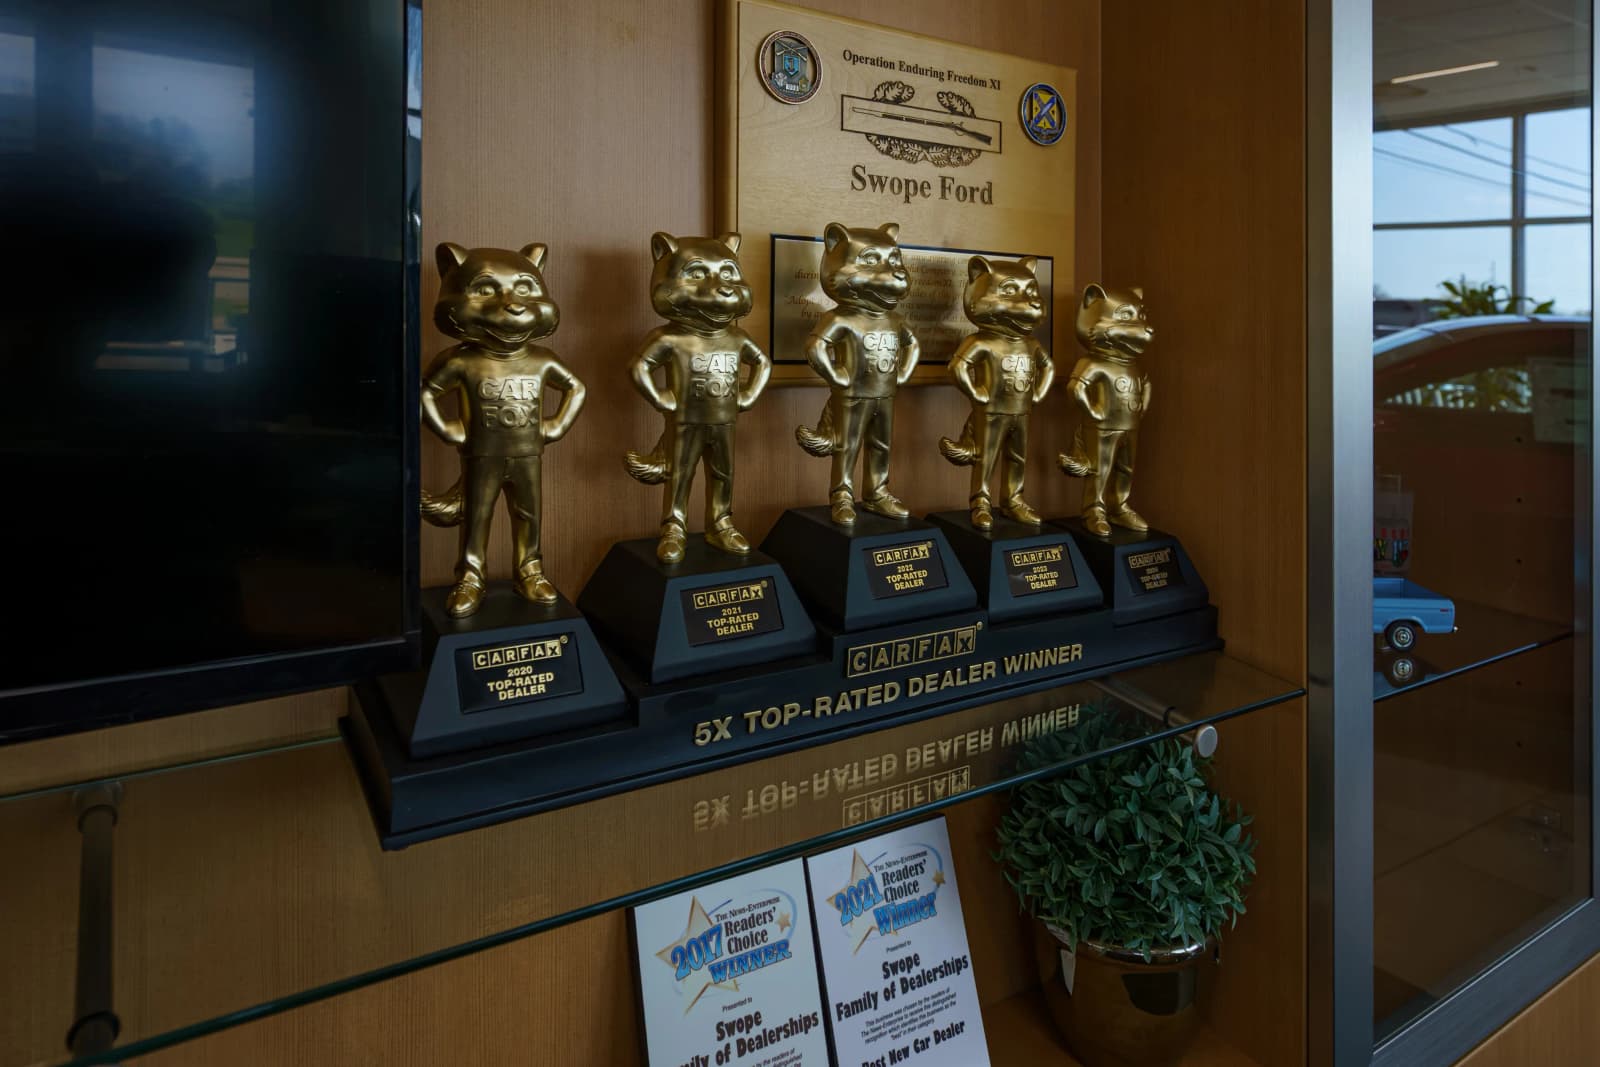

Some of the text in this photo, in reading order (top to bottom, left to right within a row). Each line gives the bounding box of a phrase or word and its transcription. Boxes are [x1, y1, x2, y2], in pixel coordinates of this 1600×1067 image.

[843, 49, 1001, 90] Operation Enduring Freedom XI
[851, 164, 993, 205] Swope Ford
[690, 353, 738, 374] CAR
[479, 374, 540, 401] CAR
[694, 375, 737, 400] FOX
[480, 401, 541, 429] FOX
[873, 544, 930, 567] CARFAX
[1012, 547, 1062, 567] CARFAX
[885, 569, 928, 583] TOP-RATED
[894, 578, 924, 591] DEALER
[692, 583, 764, 609] CARFAX
[707, 612, 760, 629] TOP-RATED
[721, 606, 742, 616] 2021
[716, 622, 755, 637] DEALER
[472, 639, 562, 670] CARFAX
[848, 625, 977, 678] CARFAX
[487, 672, 554, 692] TOP-RATED
[507, 665, 533, 678] 2020
[498, 683, 547, 701] DEALER
[694, 642, 1084, 747] 5X TOP-RATED DEALER WINNER
[881, 859, 927, 887] Readers'
[835, 873, 884, 927] 2021
[883, 879, 920, 904] Choice
[724, 906, 776, 938] Readers'
[671, 922, 724, 981] 2017
[727, 929, 769, 955] Choice
[708, 938, 793, 985] WINNER
[882, 953, 920, 980] Swope
[835, 954, 969, 1022] Family of Dealerships
[715, 1010, 762, 1041] Swope
[715, 1042, 731, 1066] of
[736, 1011, 819, 1058] Dealerships
[888, 1045, 910, 1067] New
[913, 1036, 930, 1054] Car
[933, 1020, 965, 1046] Dealer
